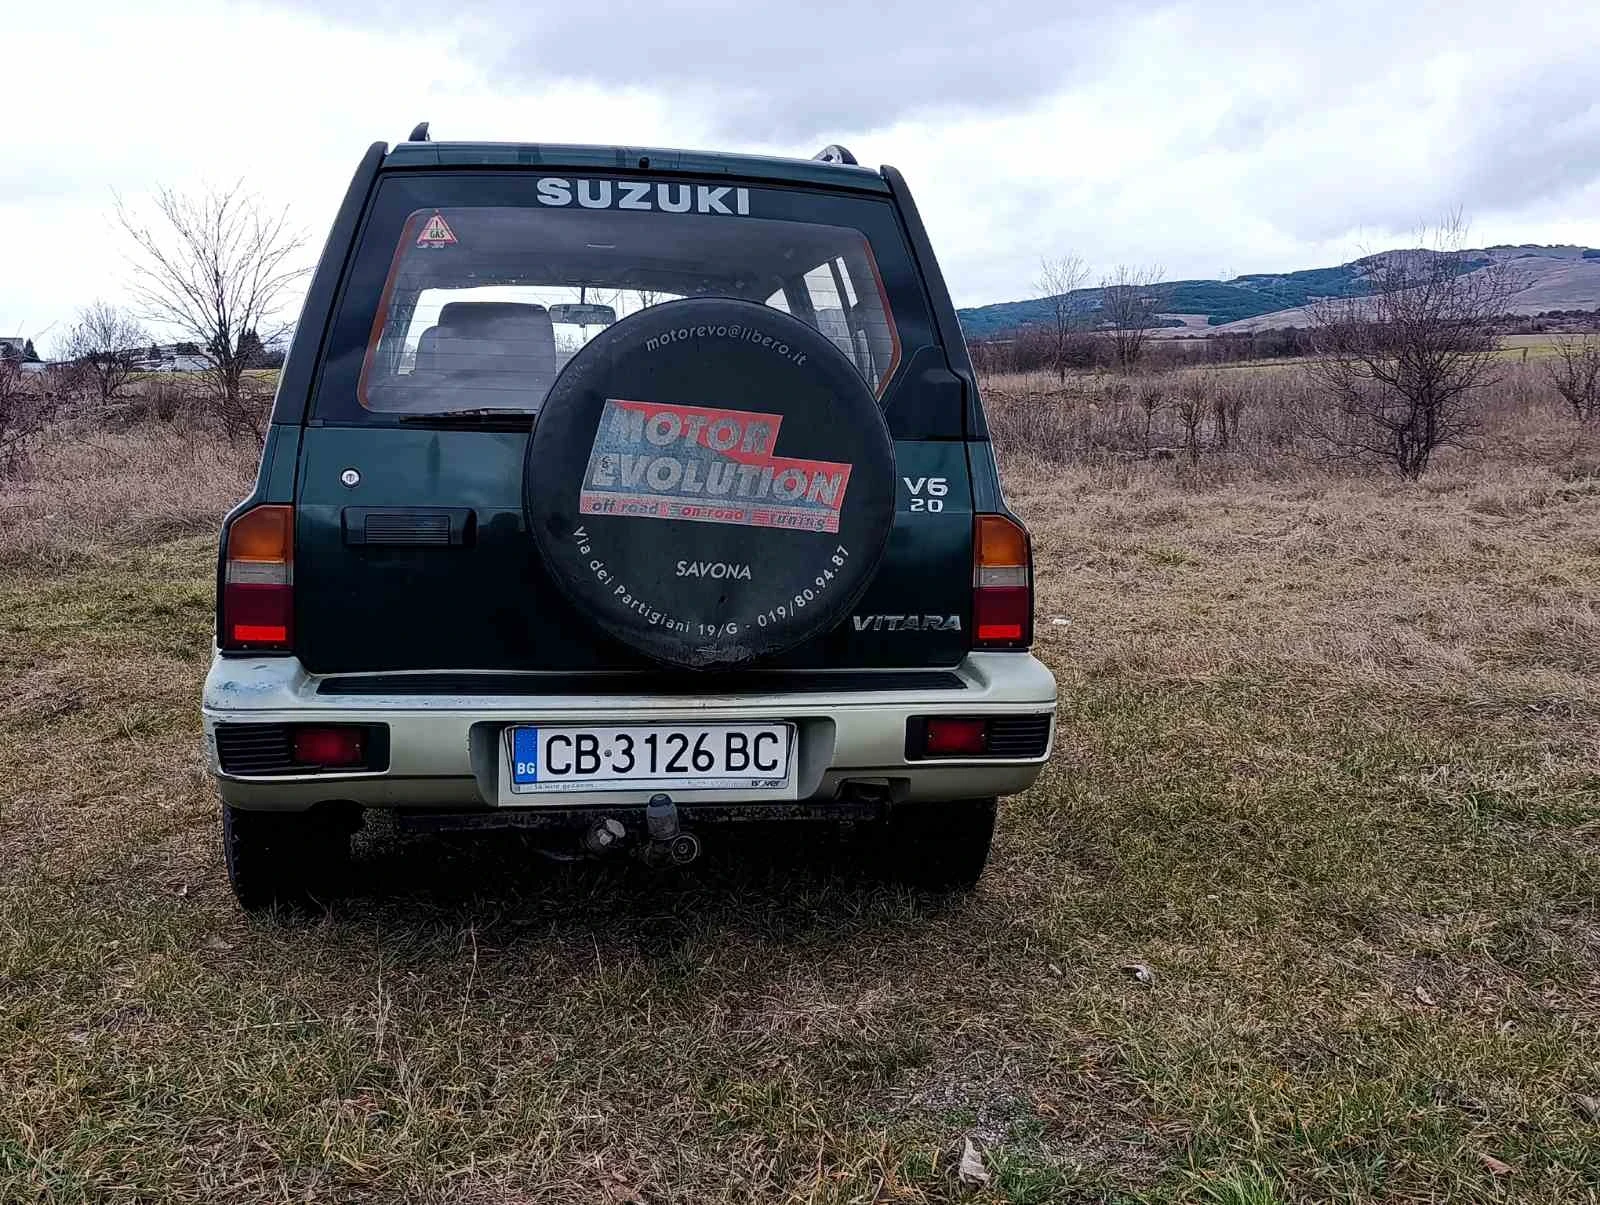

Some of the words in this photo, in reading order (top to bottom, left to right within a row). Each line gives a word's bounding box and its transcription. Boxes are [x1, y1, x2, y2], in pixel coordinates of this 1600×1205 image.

[536, 178, 750, 216] SUZUKI
[430, 230, 446, 239] GAS
[646, 324, 807, 366] motorevo@libero.it
[606, 406, 770, 456] MOTOR
[592, 453, 842, 505] EVOLUTION
[903, 477, 949, 497] V6
[910, 498, 944, 513] 20
[573, 526, 591, 555] Via
[590, 560, 615, 585] dei
[613, 585, 691, 633] Partigiani
[698, 622, 738, 639] 19/G
[757, 545, 849, 628] 019/80.94.87
[675, 560, 752, 580] SAVONA
[853, 615, 962, 632] VITARA
[545, 734, 601, 776] CB
[611, 732, 715, 774] 3126
[724, 731, 779, 773] BC
[516, 762, 536, 775] BG
